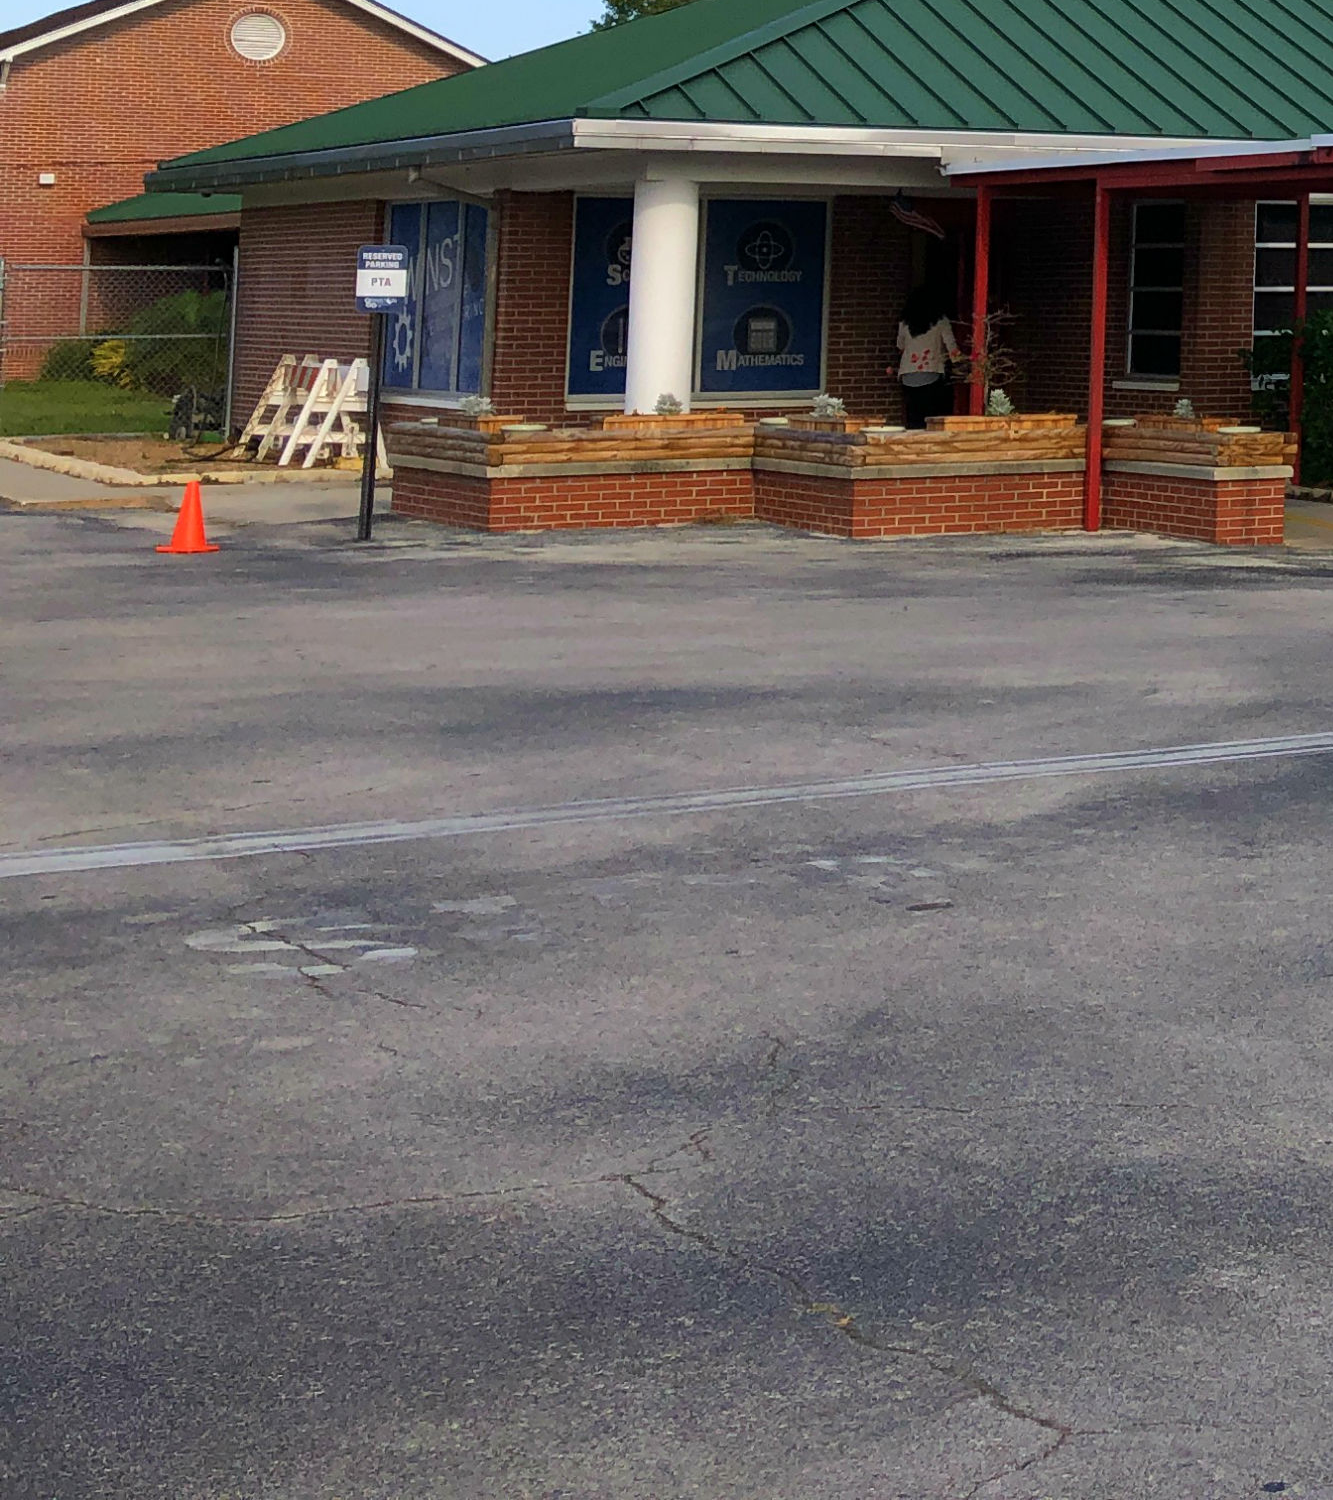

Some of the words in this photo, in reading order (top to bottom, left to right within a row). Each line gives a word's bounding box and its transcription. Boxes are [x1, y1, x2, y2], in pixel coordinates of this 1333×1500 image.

[362, 252, 403, 260] RESERVED
[365, 261, 400, 269] PARKING
[723, 264, 803, 286] TECHNOLOGY
[371, 277, 392, 287] PTA
[716, 349, 805, 371] MATHEMATICS
